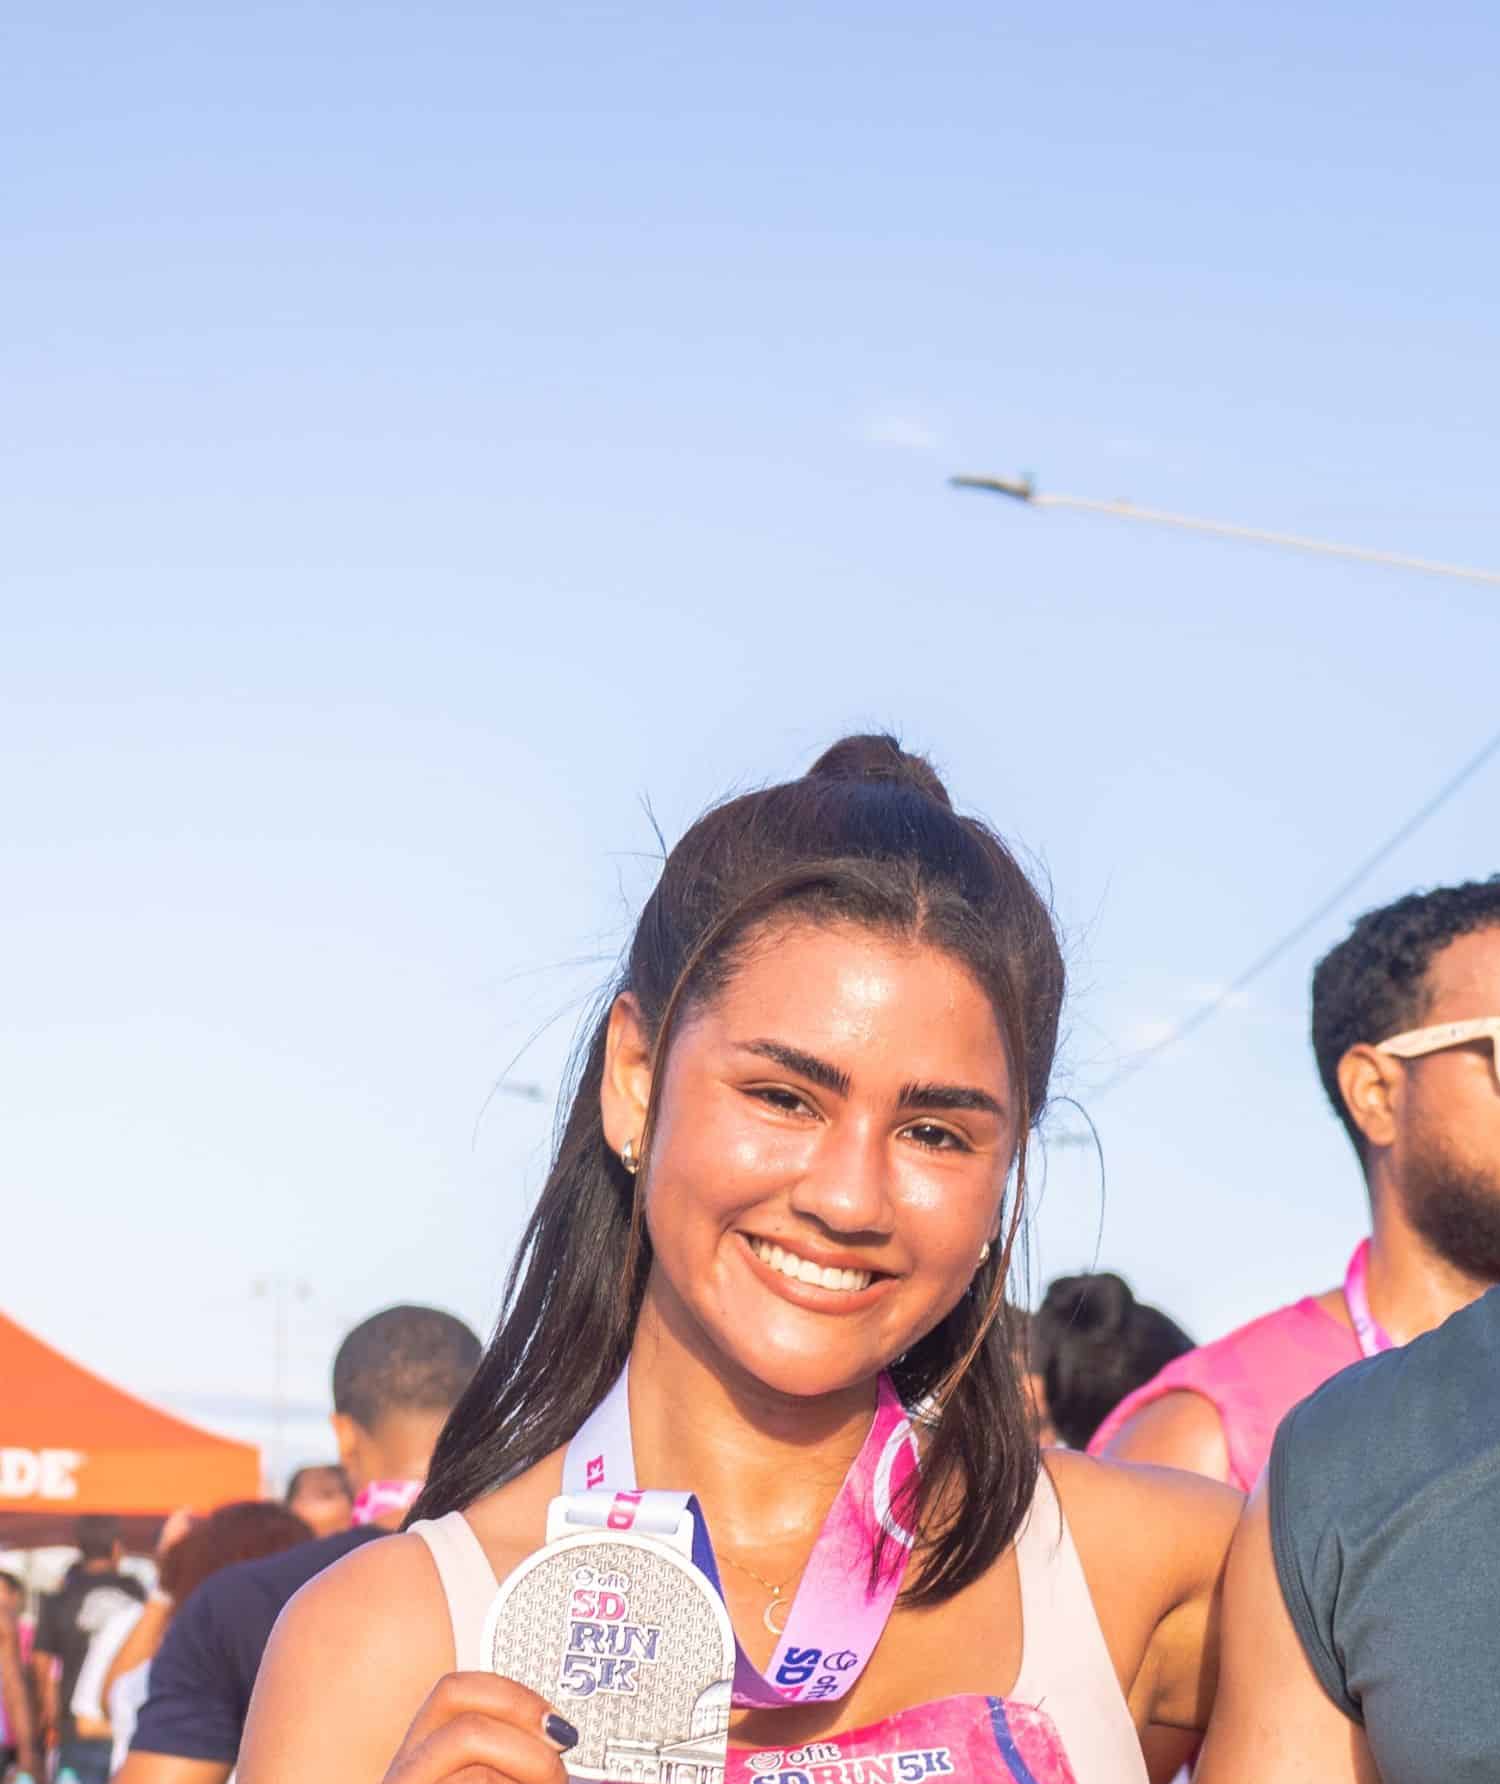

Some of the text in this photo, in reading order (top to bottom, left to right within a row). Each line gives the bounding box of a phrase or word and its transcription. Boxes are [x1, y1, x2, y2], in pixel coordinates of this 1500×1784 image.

[571, 1589, 626, 1622] SD
[568, 1621, 660, 1660] RUN
[560, 1654, 637, 1697] 5K
[789, 1744, 838, 1764] ofit
